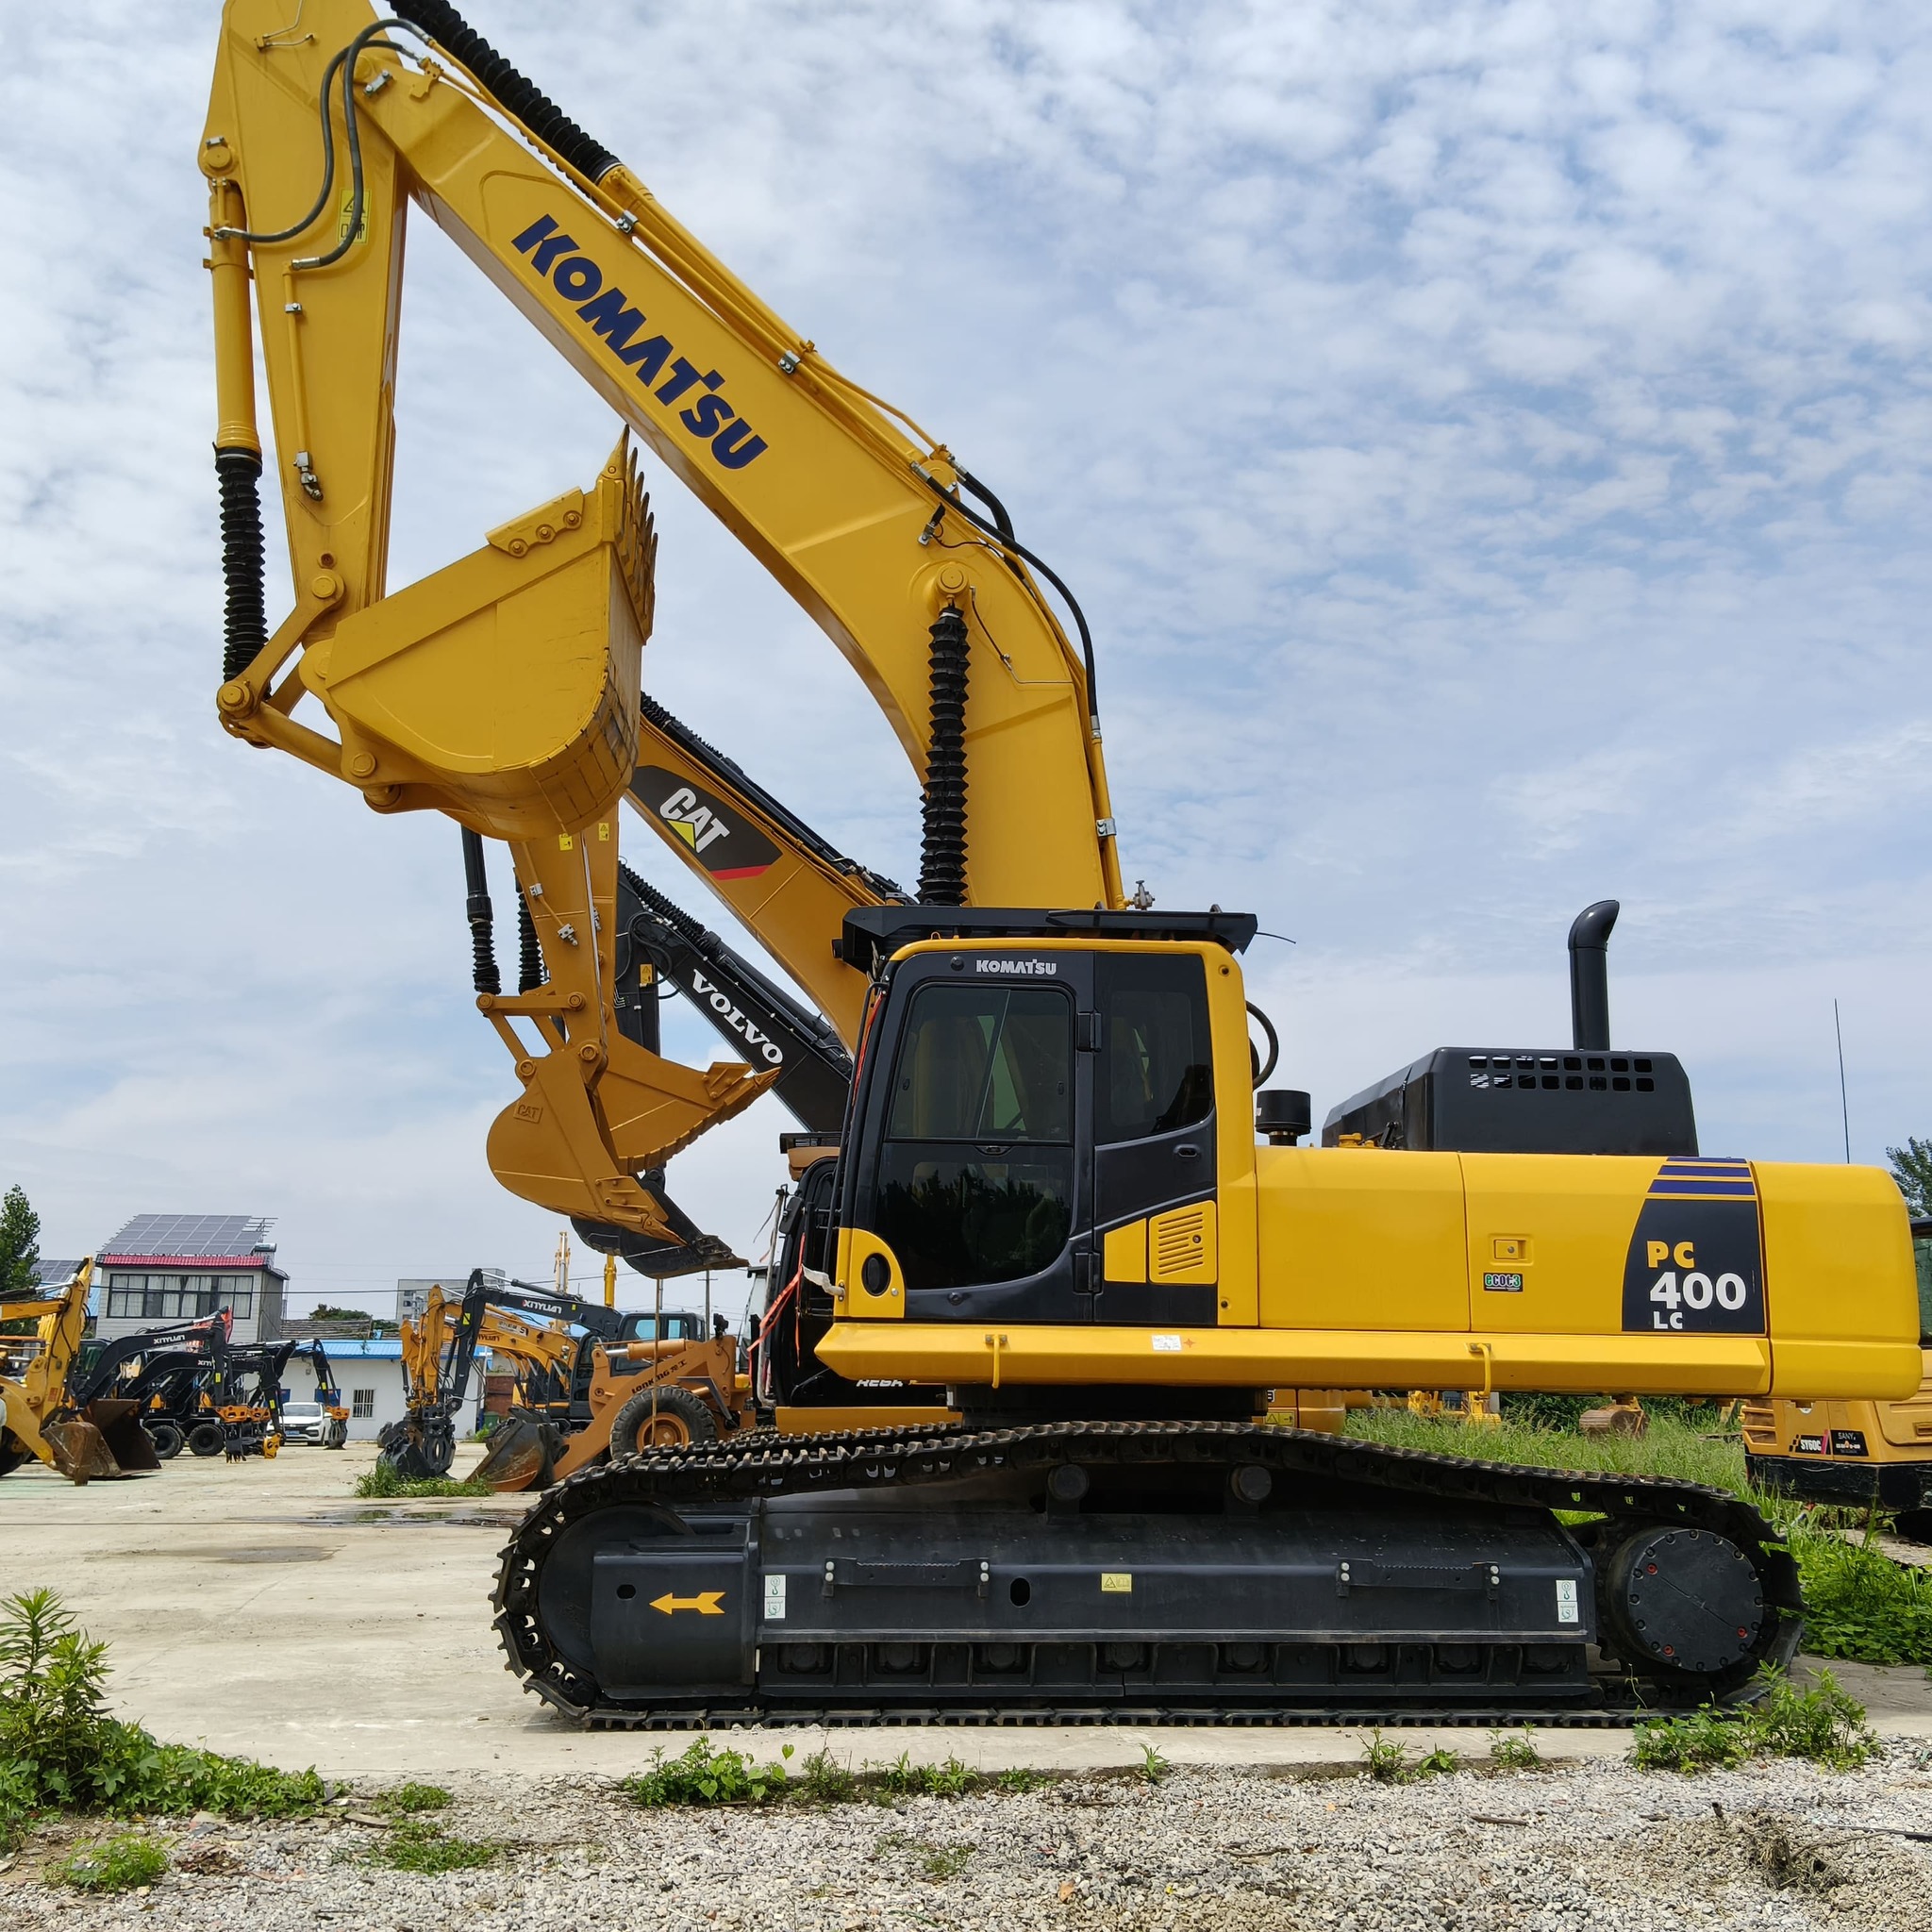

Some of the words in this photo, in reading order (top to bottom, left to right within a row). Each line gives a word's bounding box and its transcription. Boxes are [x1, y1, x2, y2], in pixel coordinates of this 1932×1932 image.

[511, 213, 769, 469] KOMATSU
[659, 788, 730, 854] CAT
[976, 958, 1057, 975] KOMATSU
[692, 969, 784, 1064] VOLVO
[518, 1104, 540, 1120] CAT
[1647, 1241, 1695, 1269] PC
[1650, 1272, 1746, 1310] 400
[1653, 1310, 1683, 1330] LC
